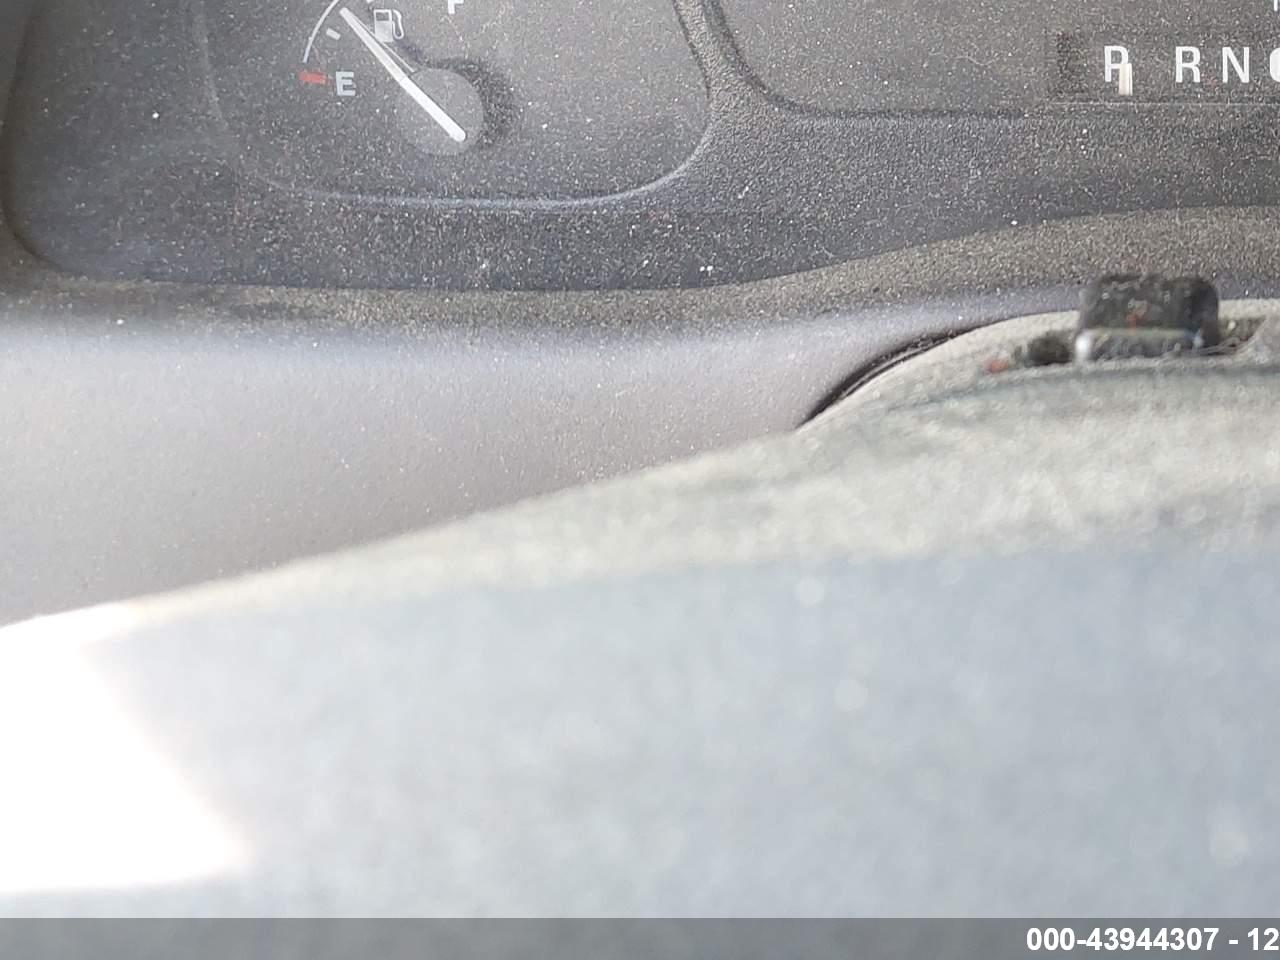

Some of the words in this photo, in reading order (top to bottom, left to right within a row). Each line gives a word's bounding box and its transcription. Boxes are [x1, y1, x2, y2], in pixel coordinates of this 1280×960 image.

[1176, 46, 1200, 82] R
[1222, 47, 1249, 83] N
[336, 71, 355, 96] E
